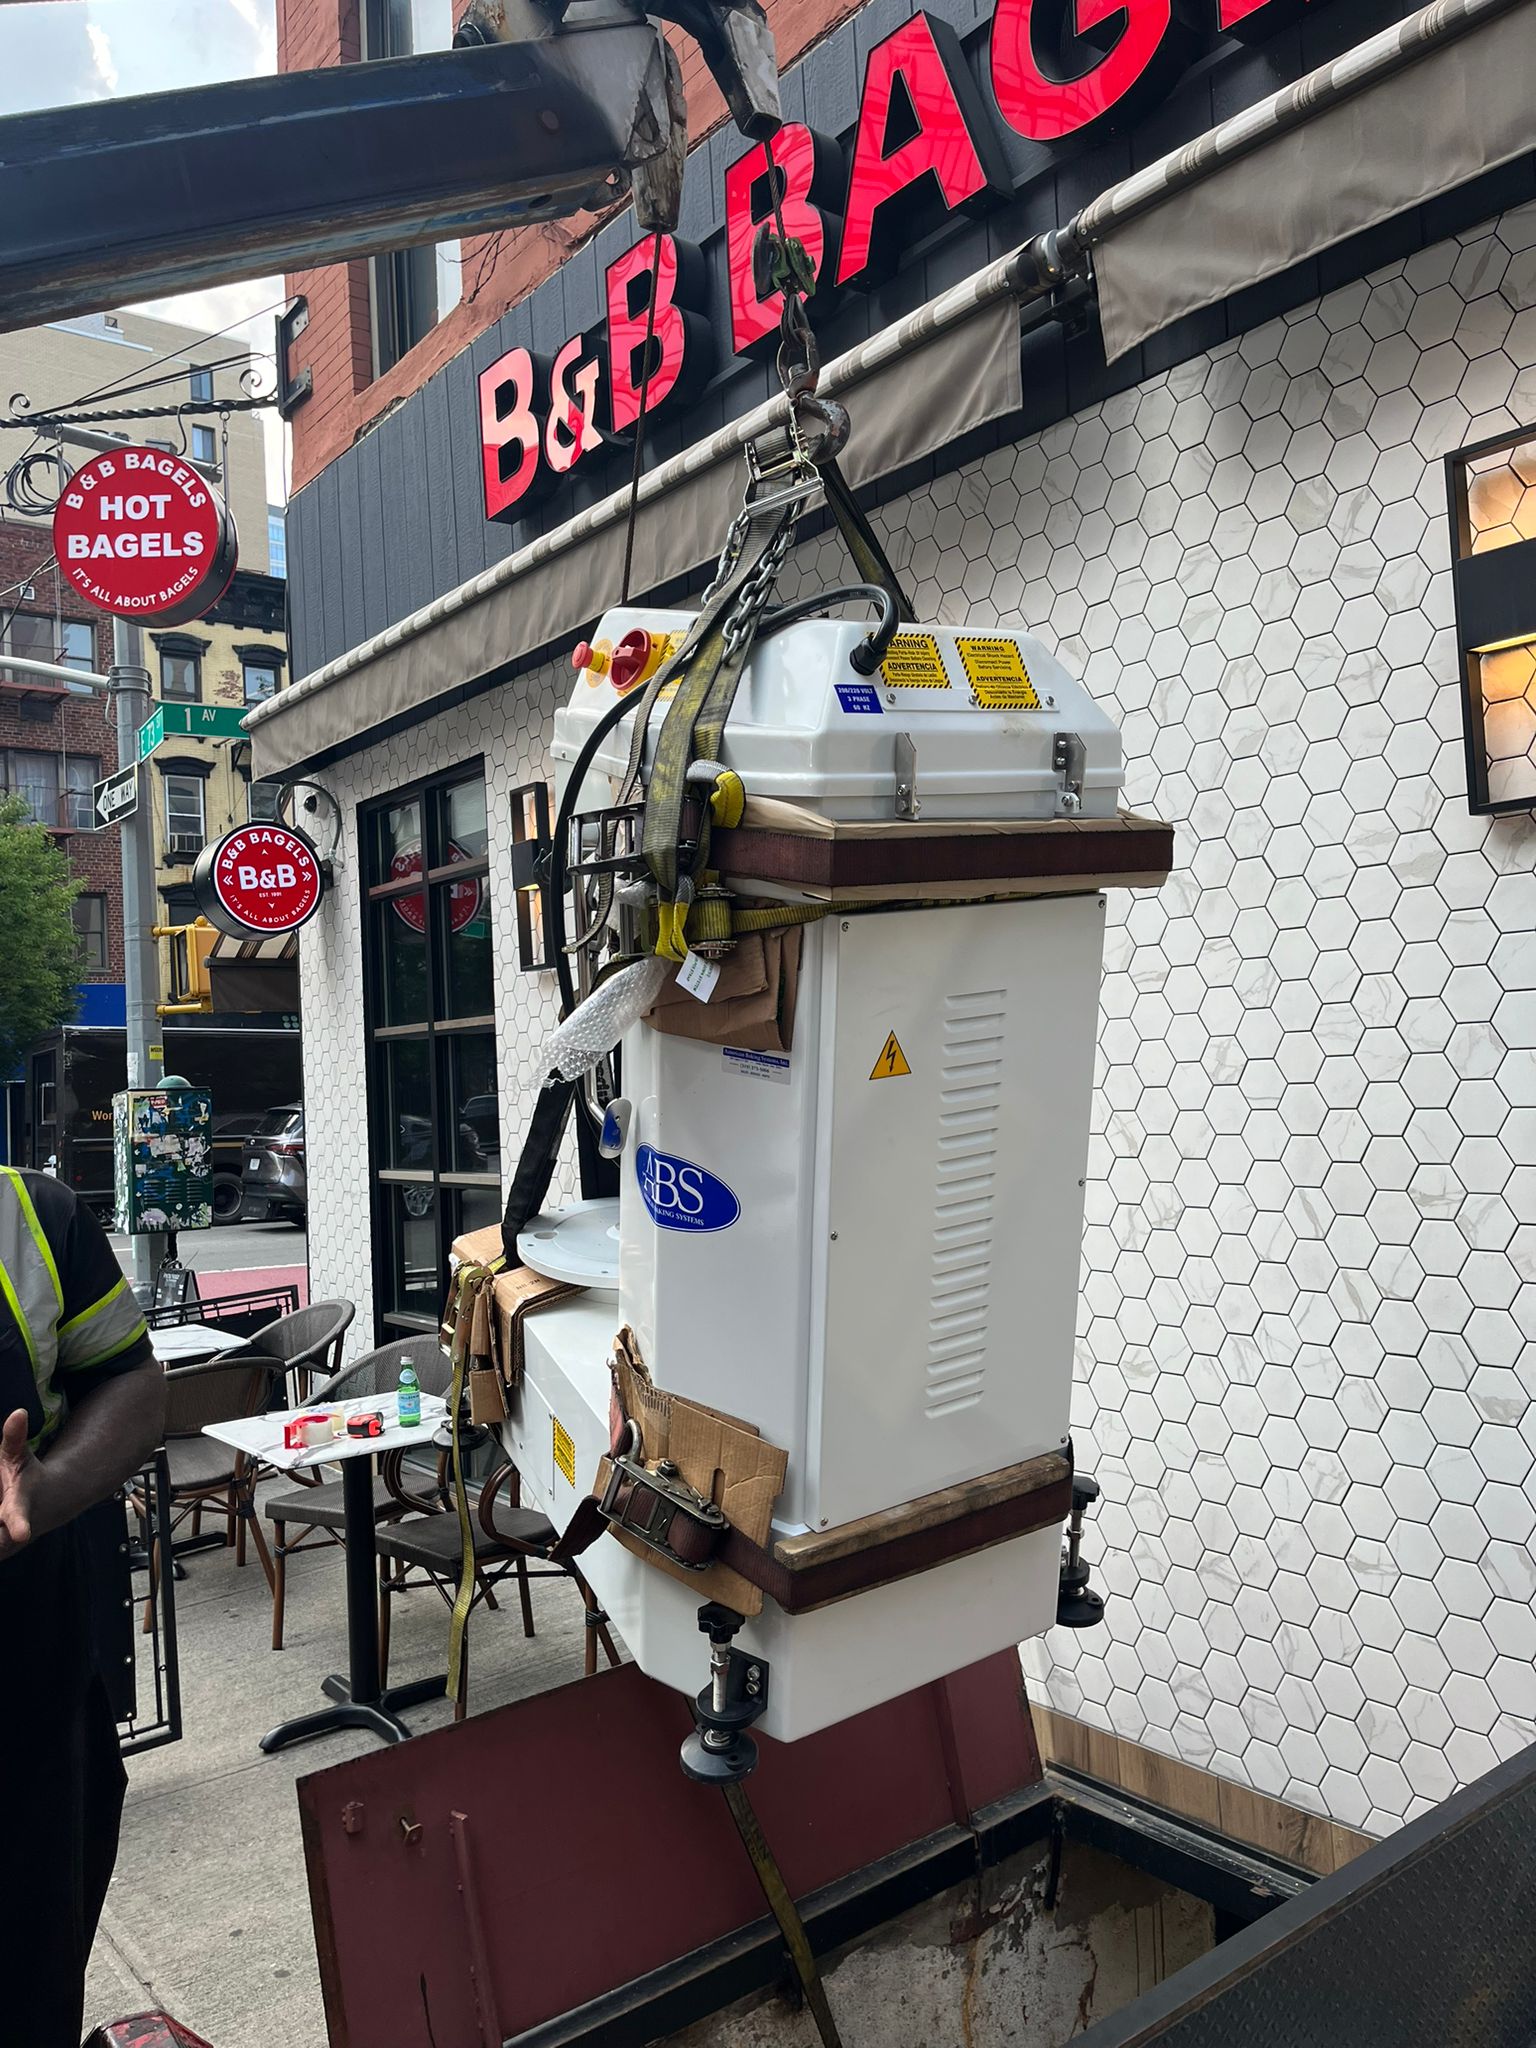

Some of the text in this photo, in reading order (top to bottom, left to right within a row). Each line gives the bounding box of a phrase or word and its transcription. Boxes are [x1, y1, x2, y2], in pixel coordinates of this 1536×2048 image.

[479, 0, 1272, 521] B&B BAG
[65, 453, 207, 510] B & B BAGELS
[100, 494, 172, 520] HOT
[68, 531, 204, 559] BAGELS
[72, 566, 199, 607] IT'S ALL ABOUT BAGELS
[888, 638, 928, 648] ARNING
[888, 662, 936, 670] ADVERTENCIA
[184, 707, 217, 731] 1 AV
[140, 730, 145, 756] E
[147, 721, 155, 748] 73
[102, 780, 134, 811] ONE WAY
[221, 831, 310, 869] B&B BAGELS
[238, 864, 297, 890] B&B
[230, 889, 311, 923] IT'S ALL ABOUT BAGELS
[643, 1151, 704, 1214] ABS
[675, 1212, 705, 1226] SYSTEMS
